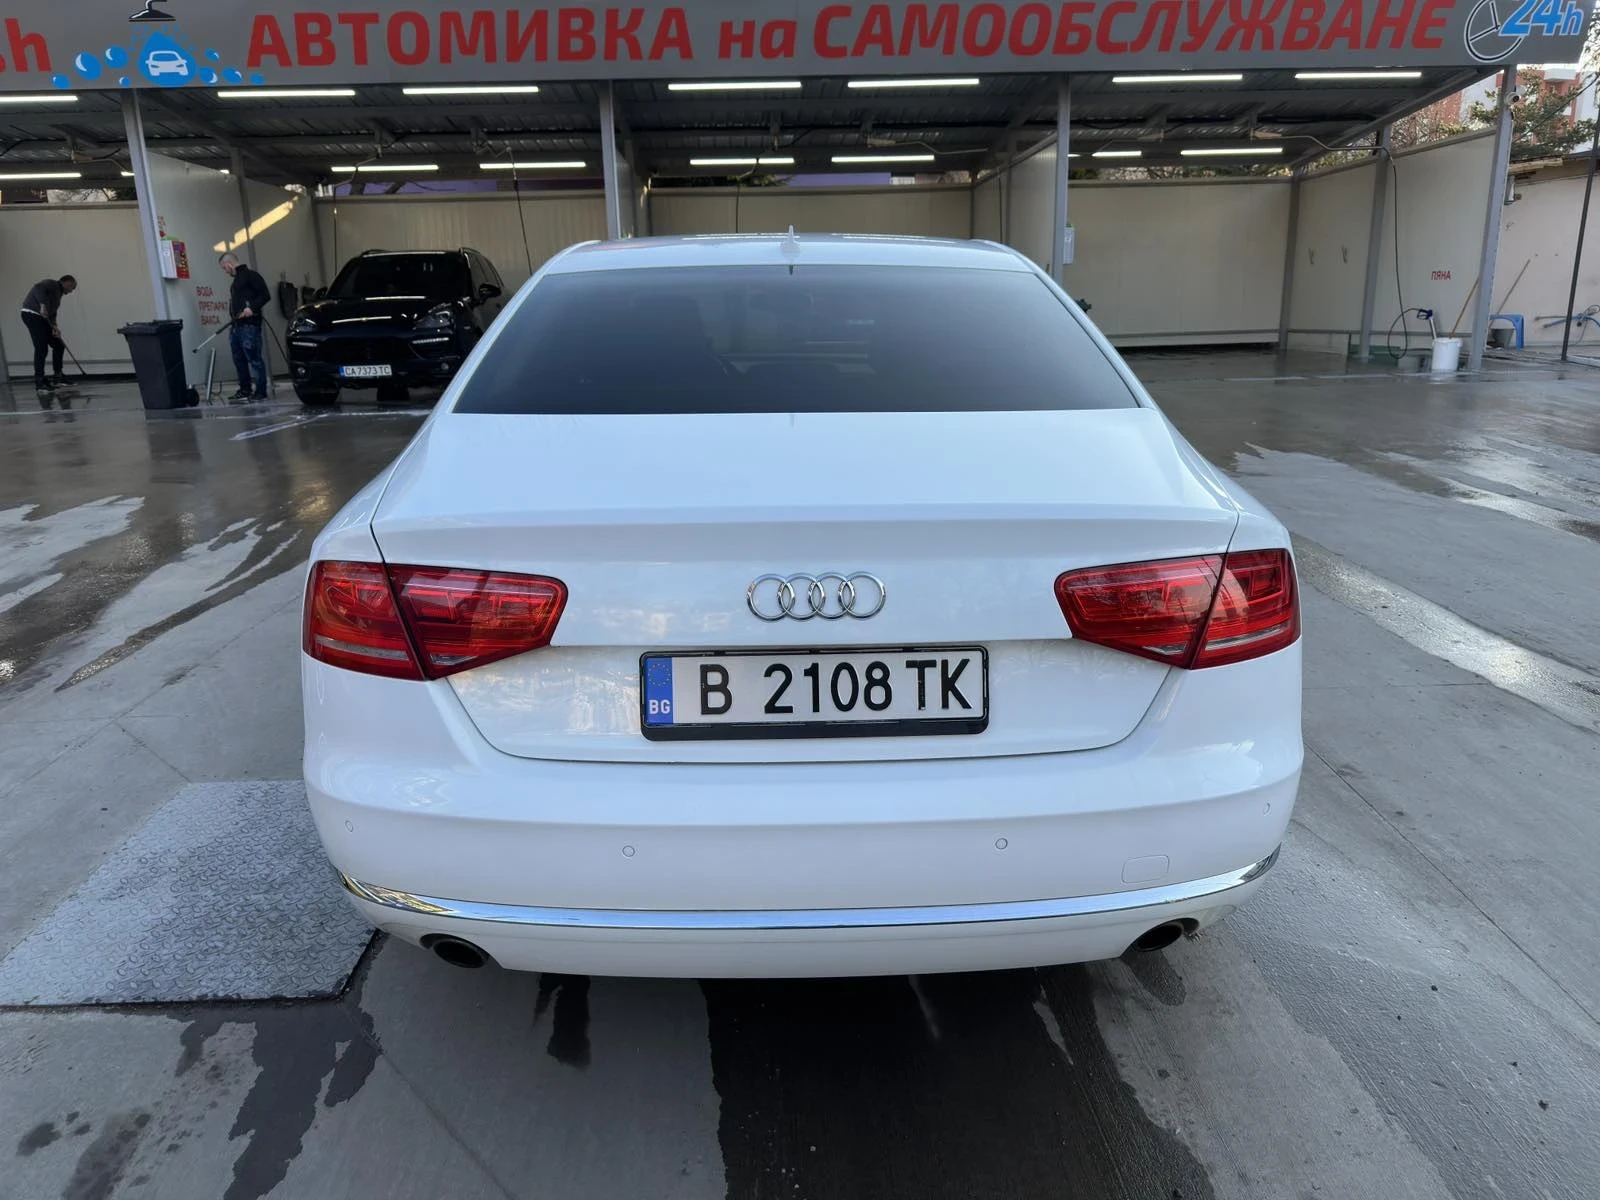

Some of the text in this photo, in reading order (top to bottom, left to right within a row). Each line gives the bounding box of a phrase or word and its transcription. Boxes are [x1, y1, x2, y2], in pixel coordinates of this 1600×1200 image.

[247, 0, 1456, 68] АВТОМИВКА на САМООБСЛУЖВАНЕ
[1498, 0, 1584, 36] 24h
[0, 18, 52, 73] h
[1430, 270, 1452, 281] ПЯНА
[649, 700, 670, 715] BG
[700, 658, 973, 715] B 2108 TK
